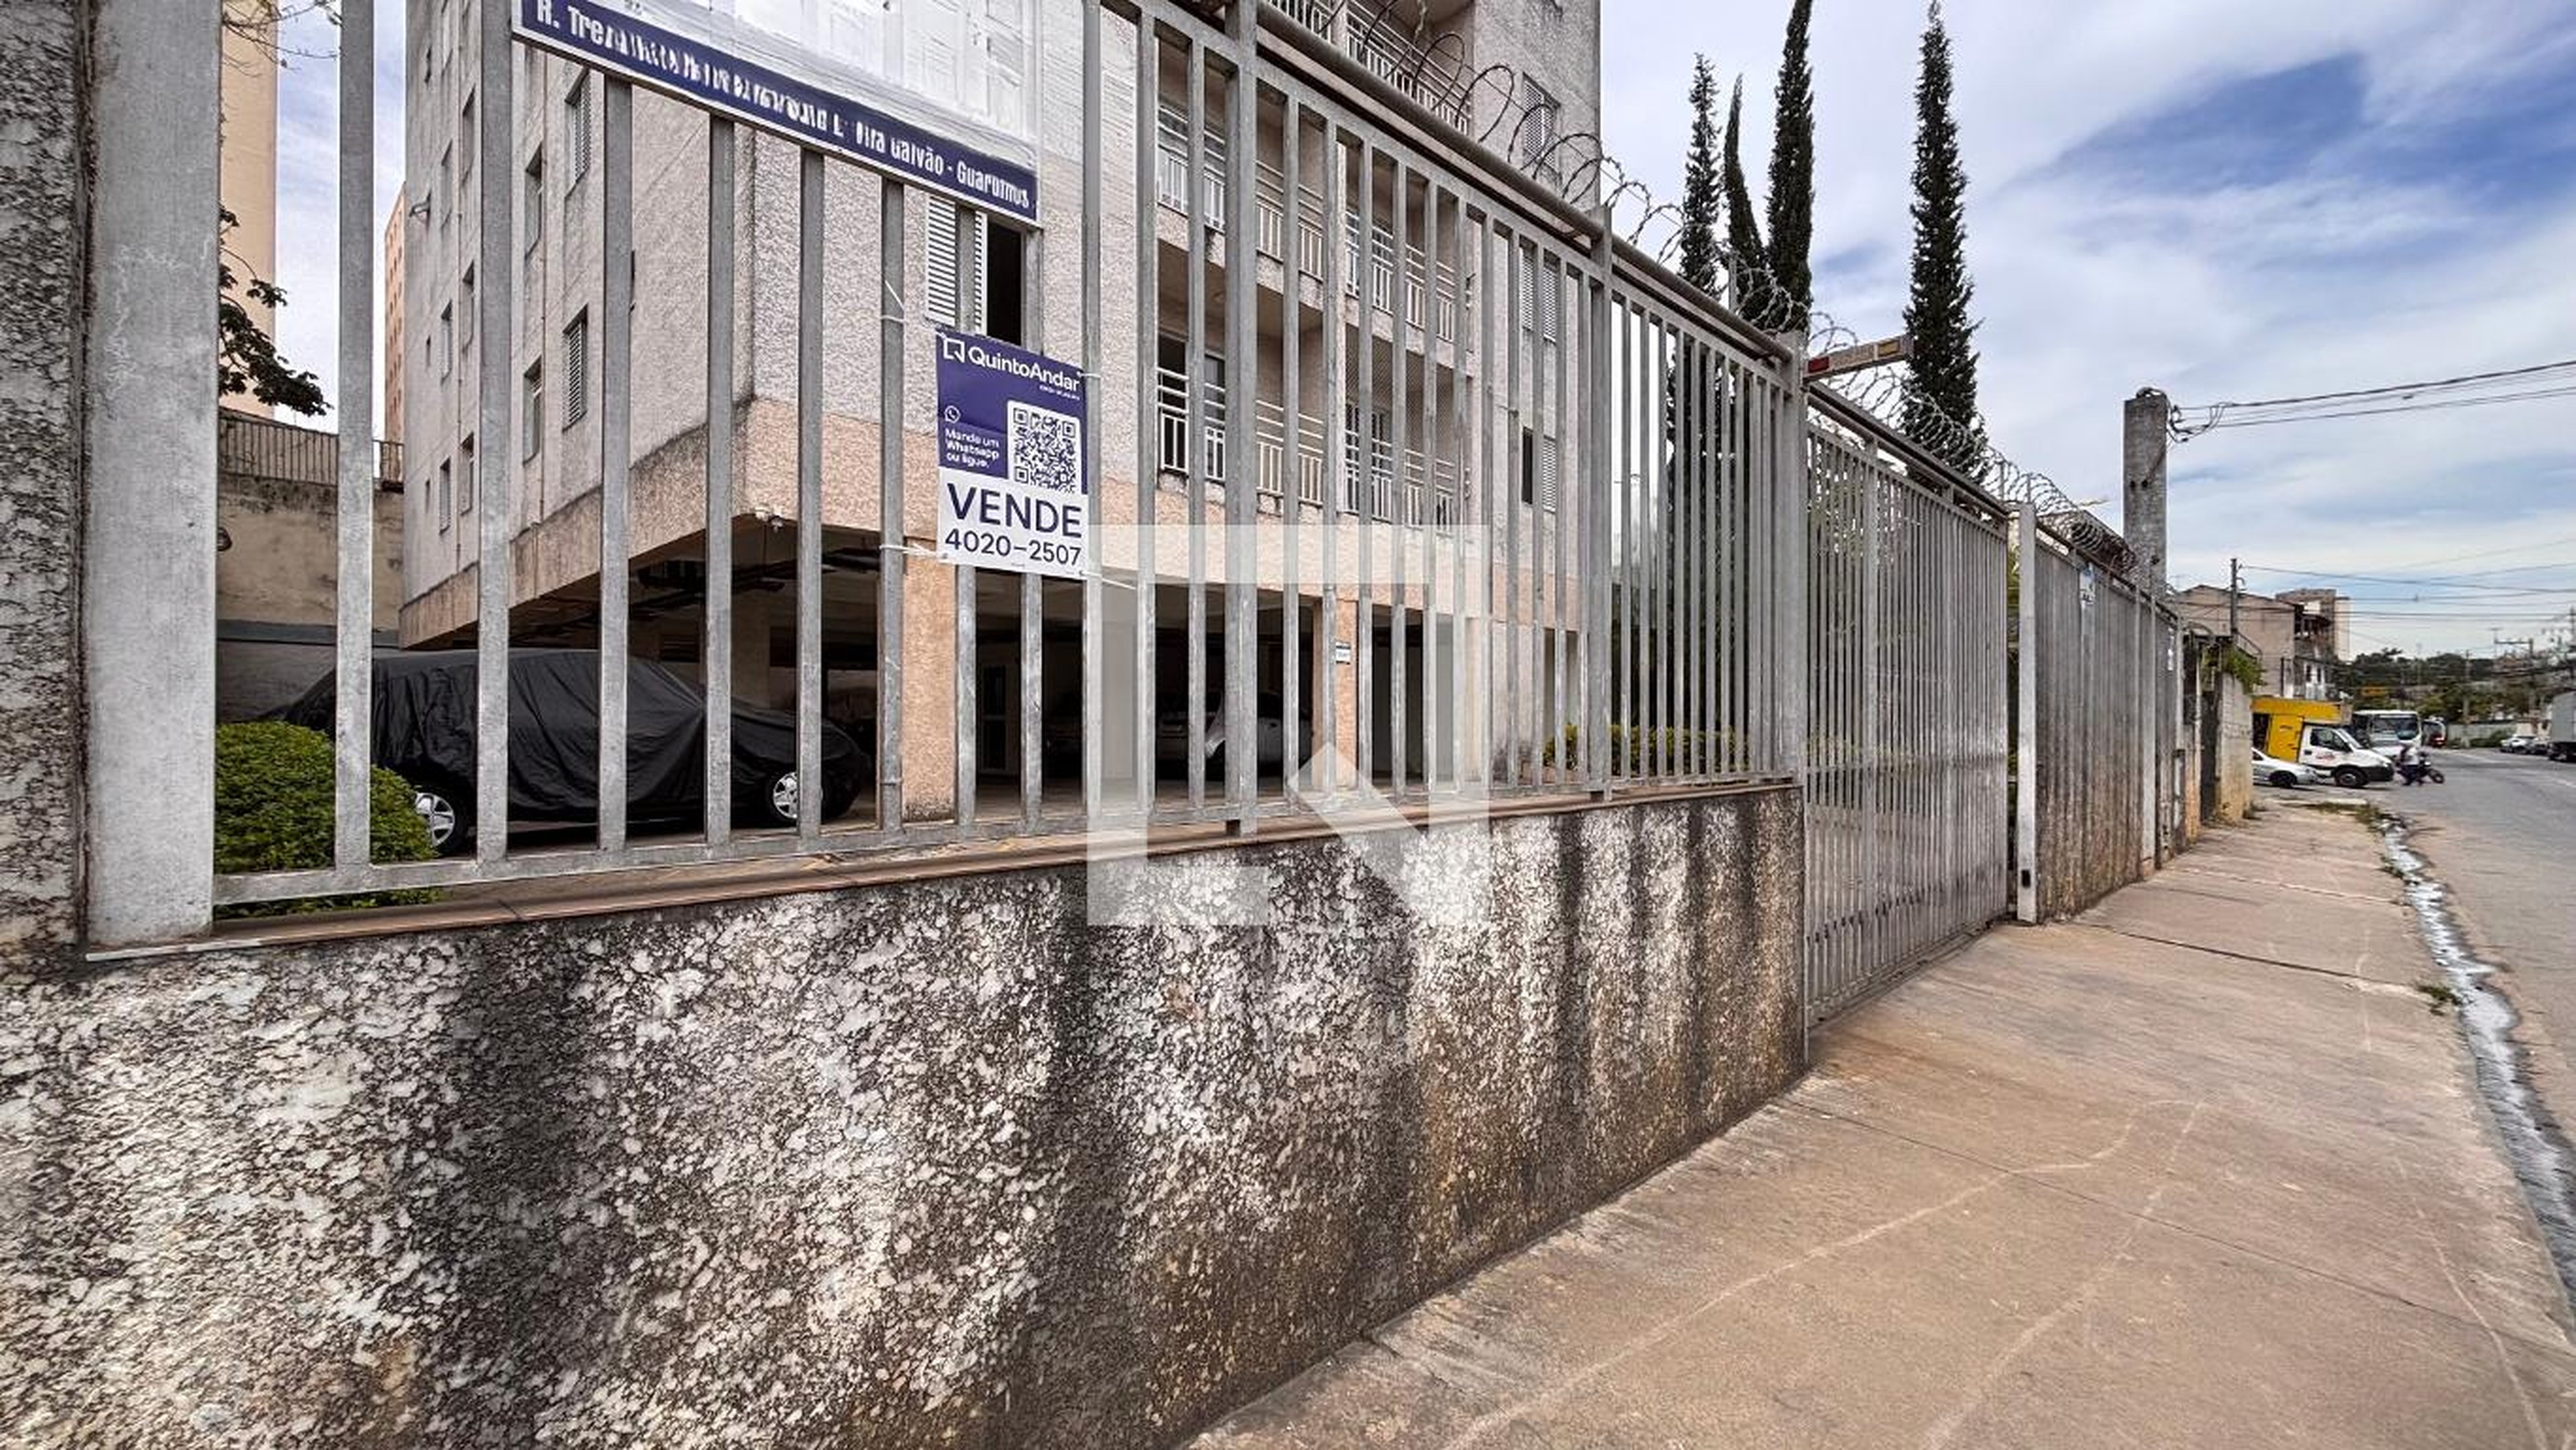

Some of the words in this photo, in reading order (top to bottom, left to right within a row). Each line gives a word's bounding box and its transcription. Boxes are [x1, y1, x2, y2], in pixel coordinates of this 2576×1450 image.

[968, 346, 1080, 392] QuintoAndar
[947, 452, 960, 462] ou
[983, 437, 1000, 448] um
[947, 482, 1082, 538] VENDE
[945, 528, 1082, 566] 4020-2507
